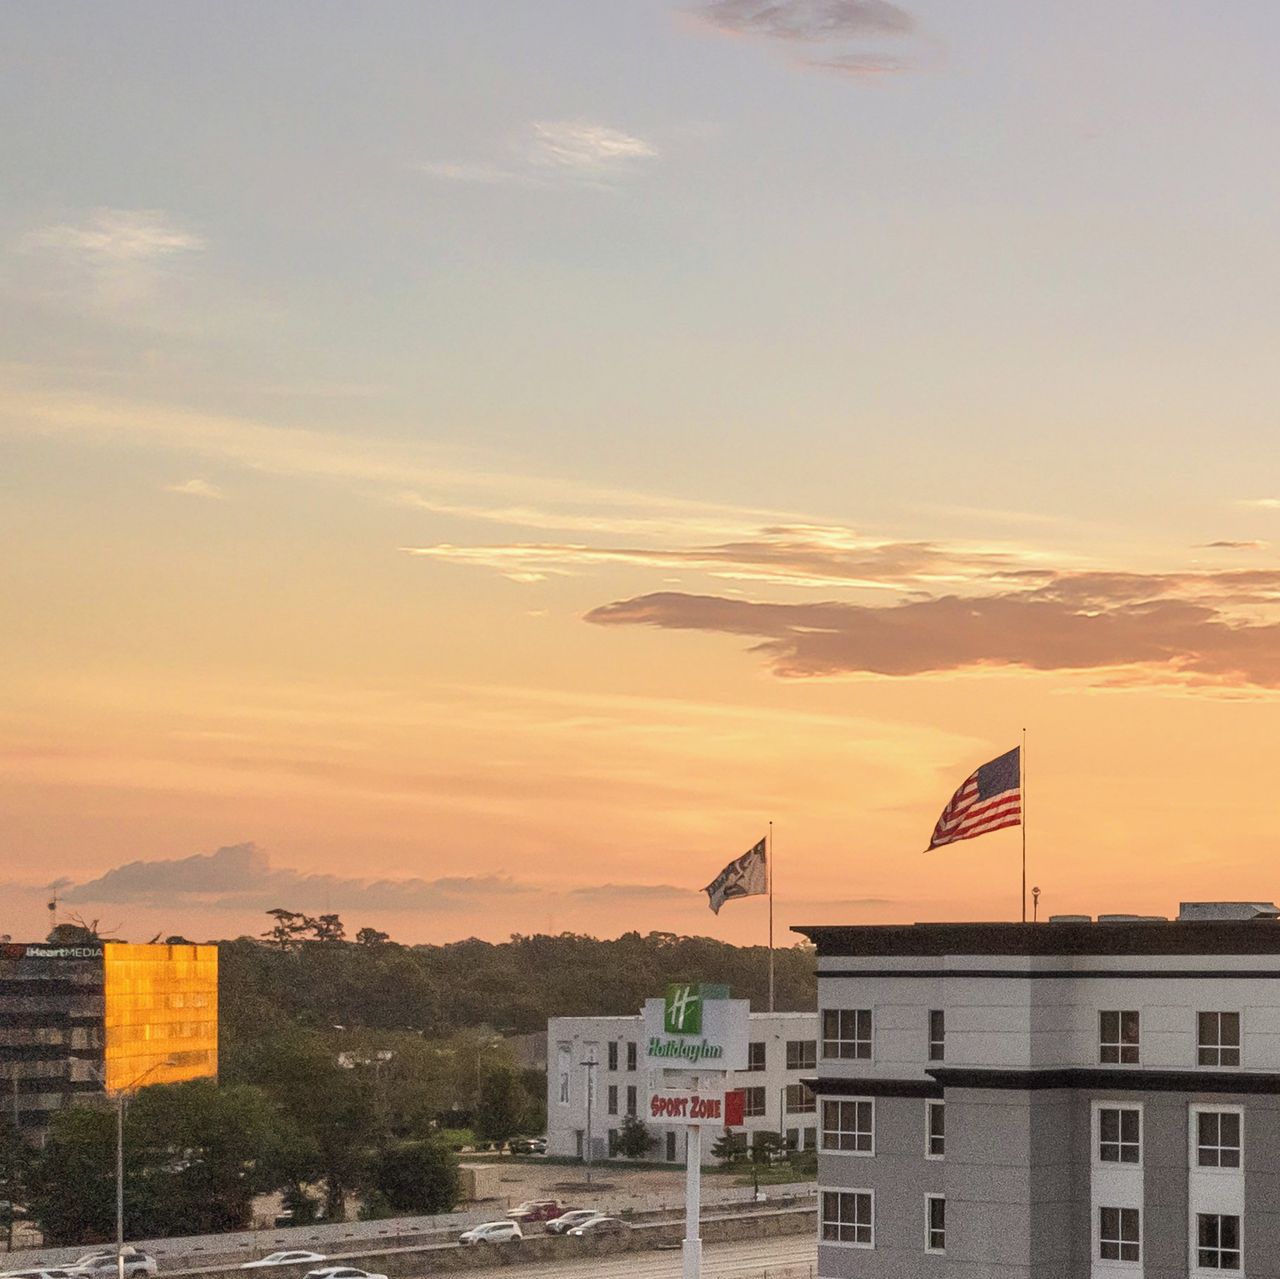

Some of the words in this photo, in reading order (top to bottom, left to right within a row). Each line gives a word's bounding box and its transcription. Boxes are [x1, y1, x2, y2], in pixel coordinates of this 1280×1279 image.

[648, 1038, 701, 1063] Holiday
[699, 1038, 723, 1058] Inn
[651, 1094, 688, 1117] SPORT
[690, 1096, 721, 1119] ZONE
